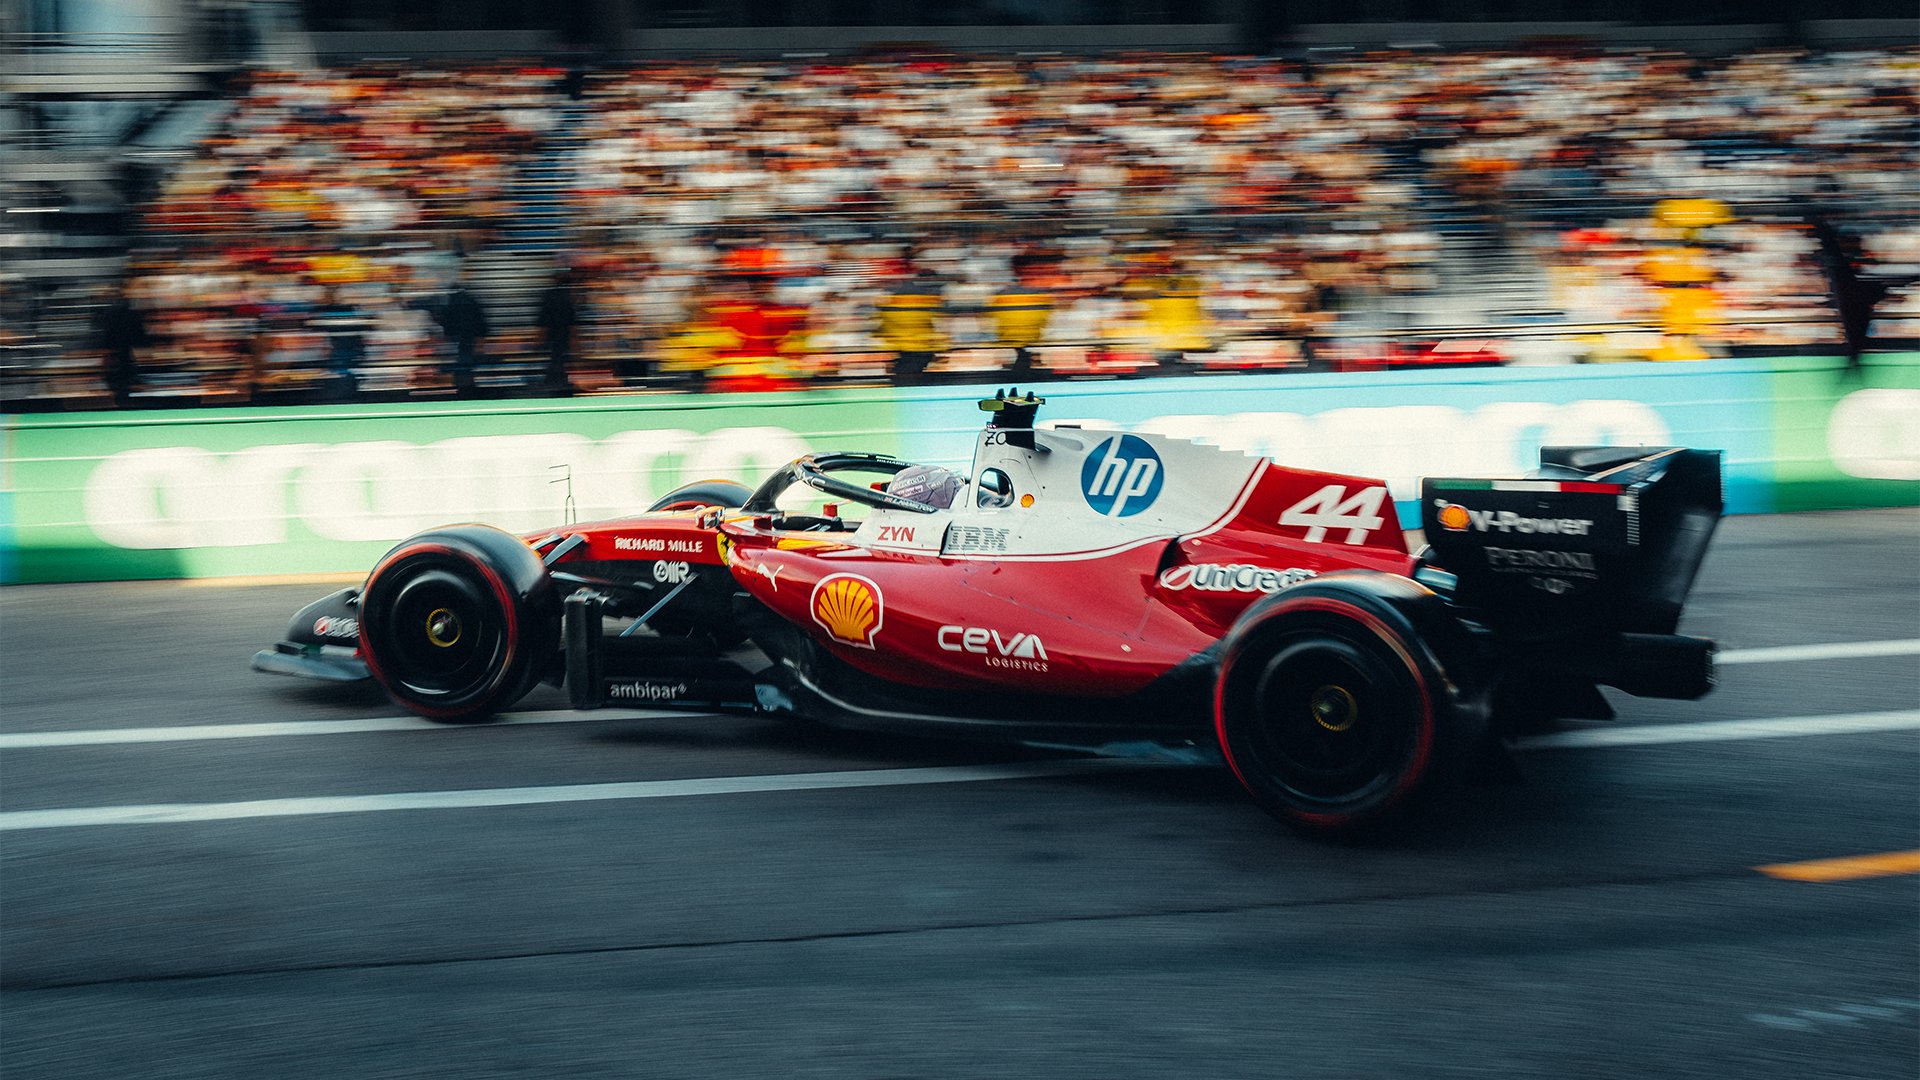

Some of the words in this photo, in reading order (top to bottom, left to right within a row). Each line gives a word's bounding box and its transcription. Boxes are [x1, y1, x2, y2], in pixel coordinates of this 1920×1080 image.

[1087, 434, 1159, 517] hp
[1278, 485, 1388, 545] 44
[1469, 510, 1594, 535] V-Power
[614, 537, 665, 551] RICHARD
[668, 540, 703, 553] MILLE
[877, 526, 916, 543] ZYN
[948, 526, 1010, 551] IBM
[1483, 546, 1598, 571] PERONI
[985, 656, 1049, 673] LOGISTICS
[610, 682, 677, 701] ambipar
